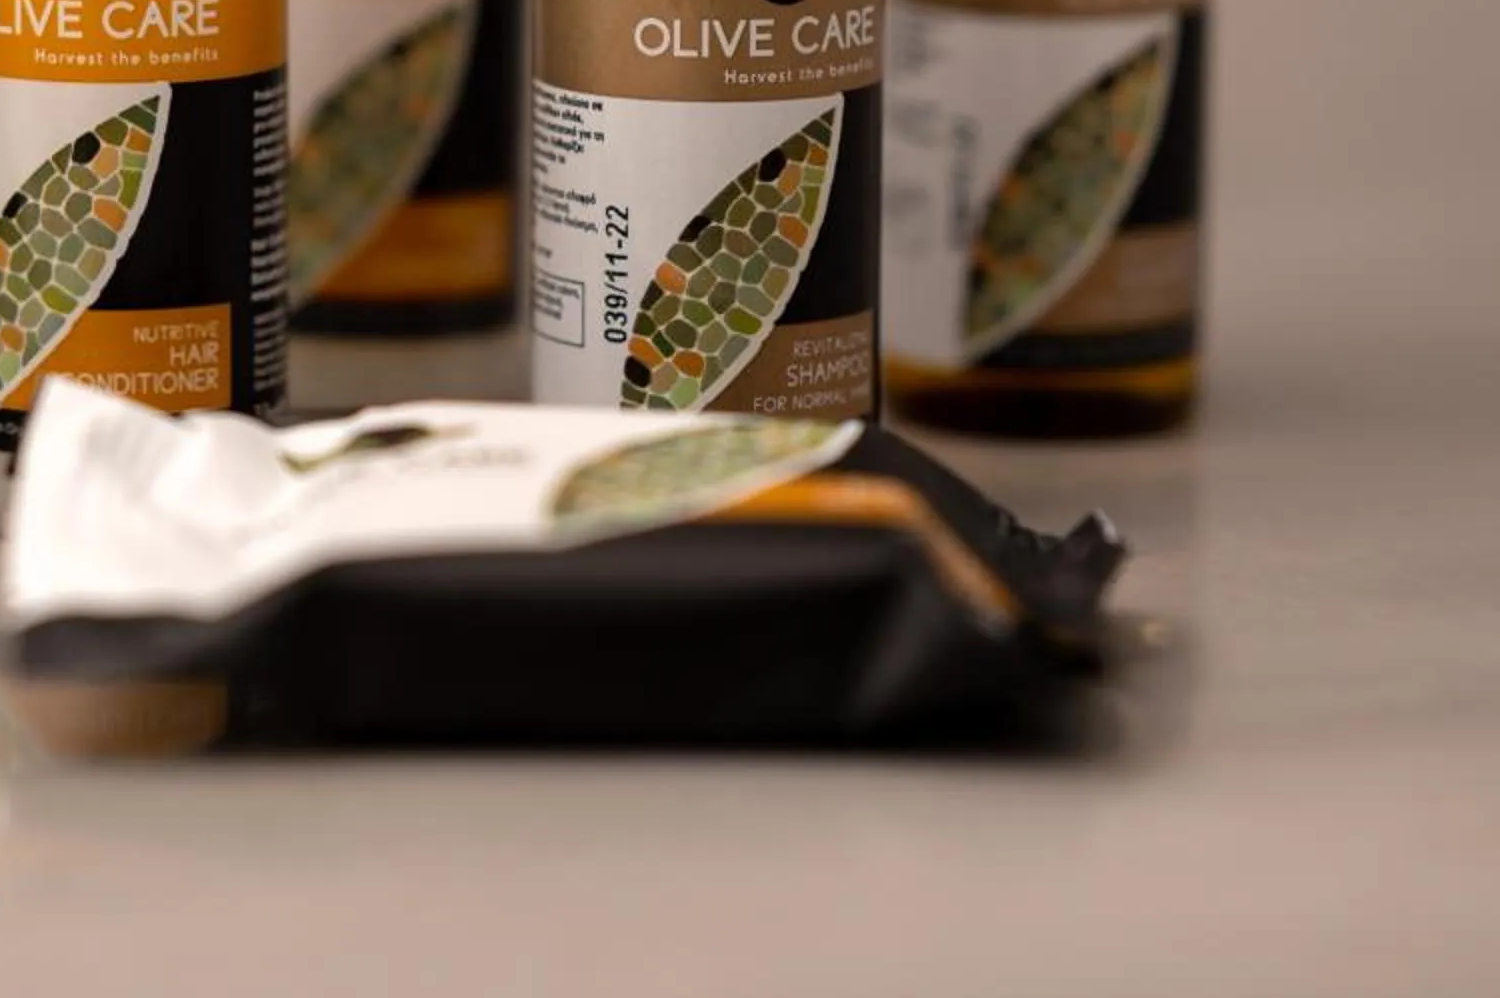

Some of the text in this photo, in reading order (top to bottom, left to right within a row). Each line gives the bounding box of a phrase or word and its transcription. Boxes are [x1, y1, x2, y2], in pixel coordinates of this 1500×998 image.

[633, 16, 775, 58] OLIVE
[791, 5, 875, 55] CARE
[34, 47, 219, 66] Harvest the benefits
[723, 68, 793, 85] Harvest
[799, 65, 824, 81] the
[604, 205, 629, 344] 039/11-22
[133, 320, 220, 343] NUTRITIVE
[170, 342, 220, 367] HAIR
[64, 368, 220, 395] ONDITIONER
[753, 395, 787, 412] FOR
